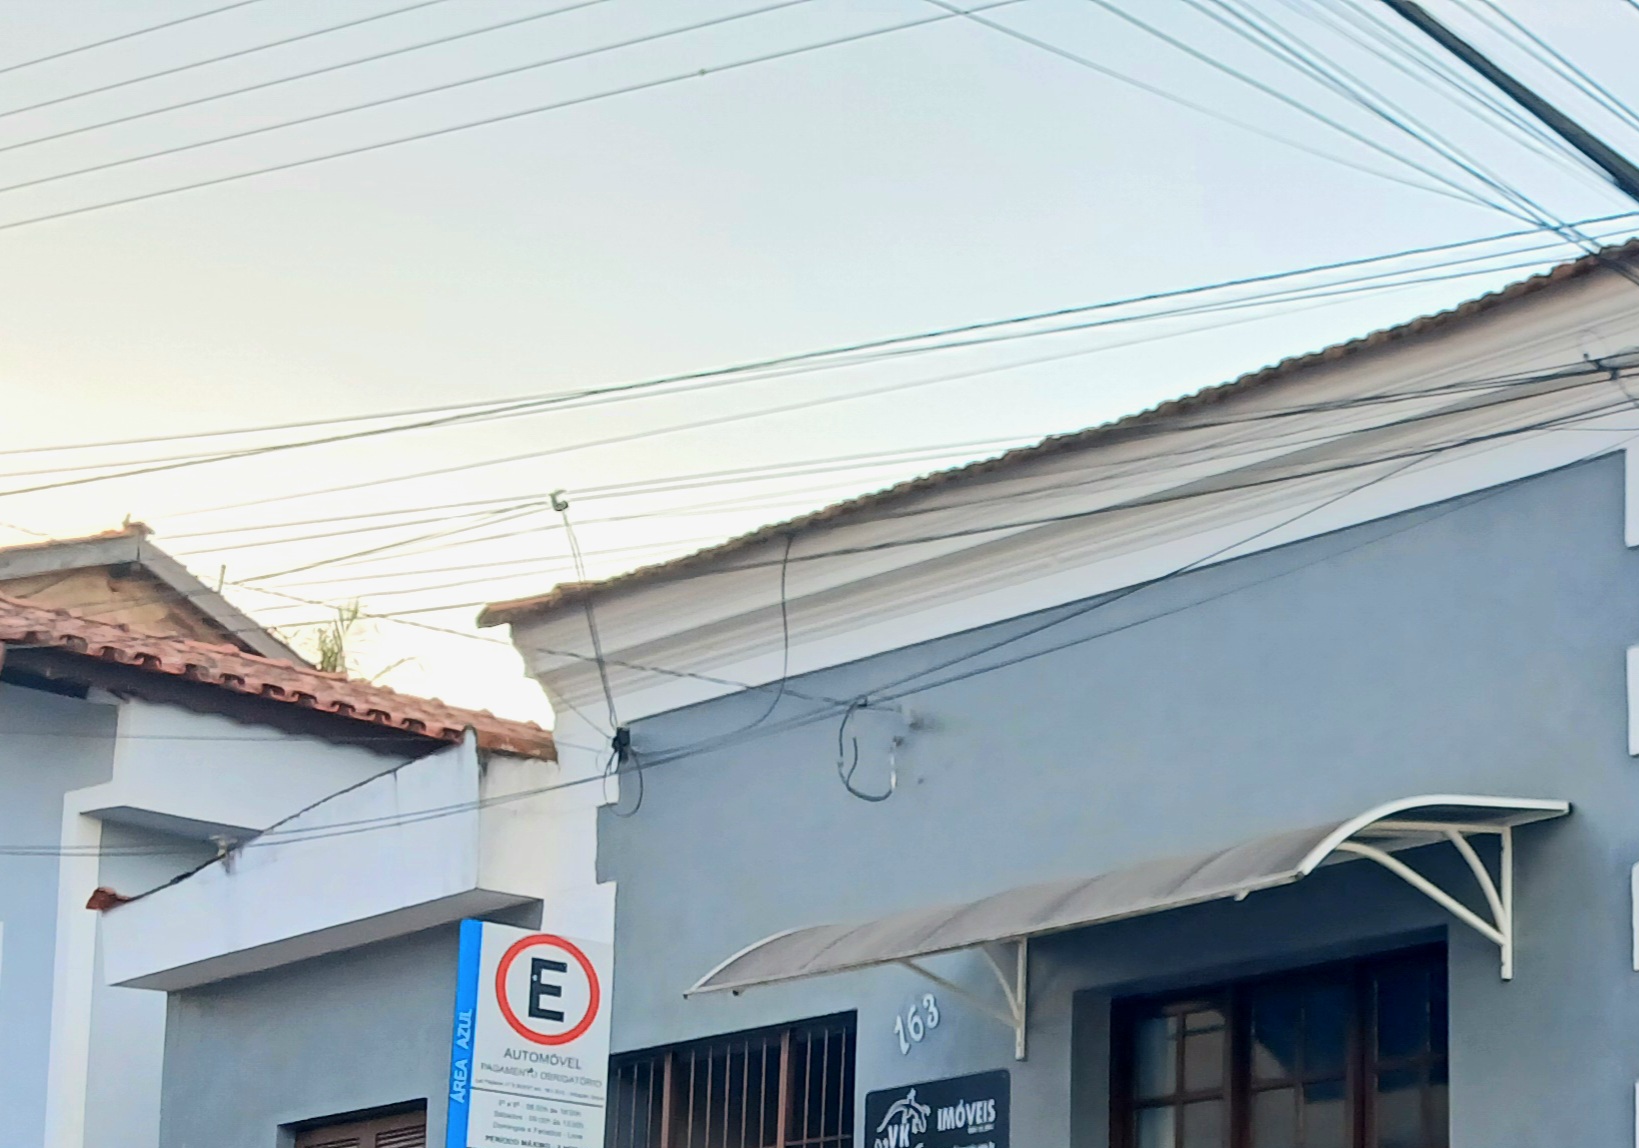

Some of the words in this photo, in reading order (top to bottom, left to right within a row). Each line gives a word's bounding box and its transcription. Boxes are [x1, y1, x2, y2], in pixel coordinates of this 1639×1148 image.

[528, 957, 568, 1023] E
[455, 1008, 473, 1050] AZUL
[503, 1048, 582, 1070] AUTOMÓVEL
[937, 1098, 996, 1132] IMÓVEIS
